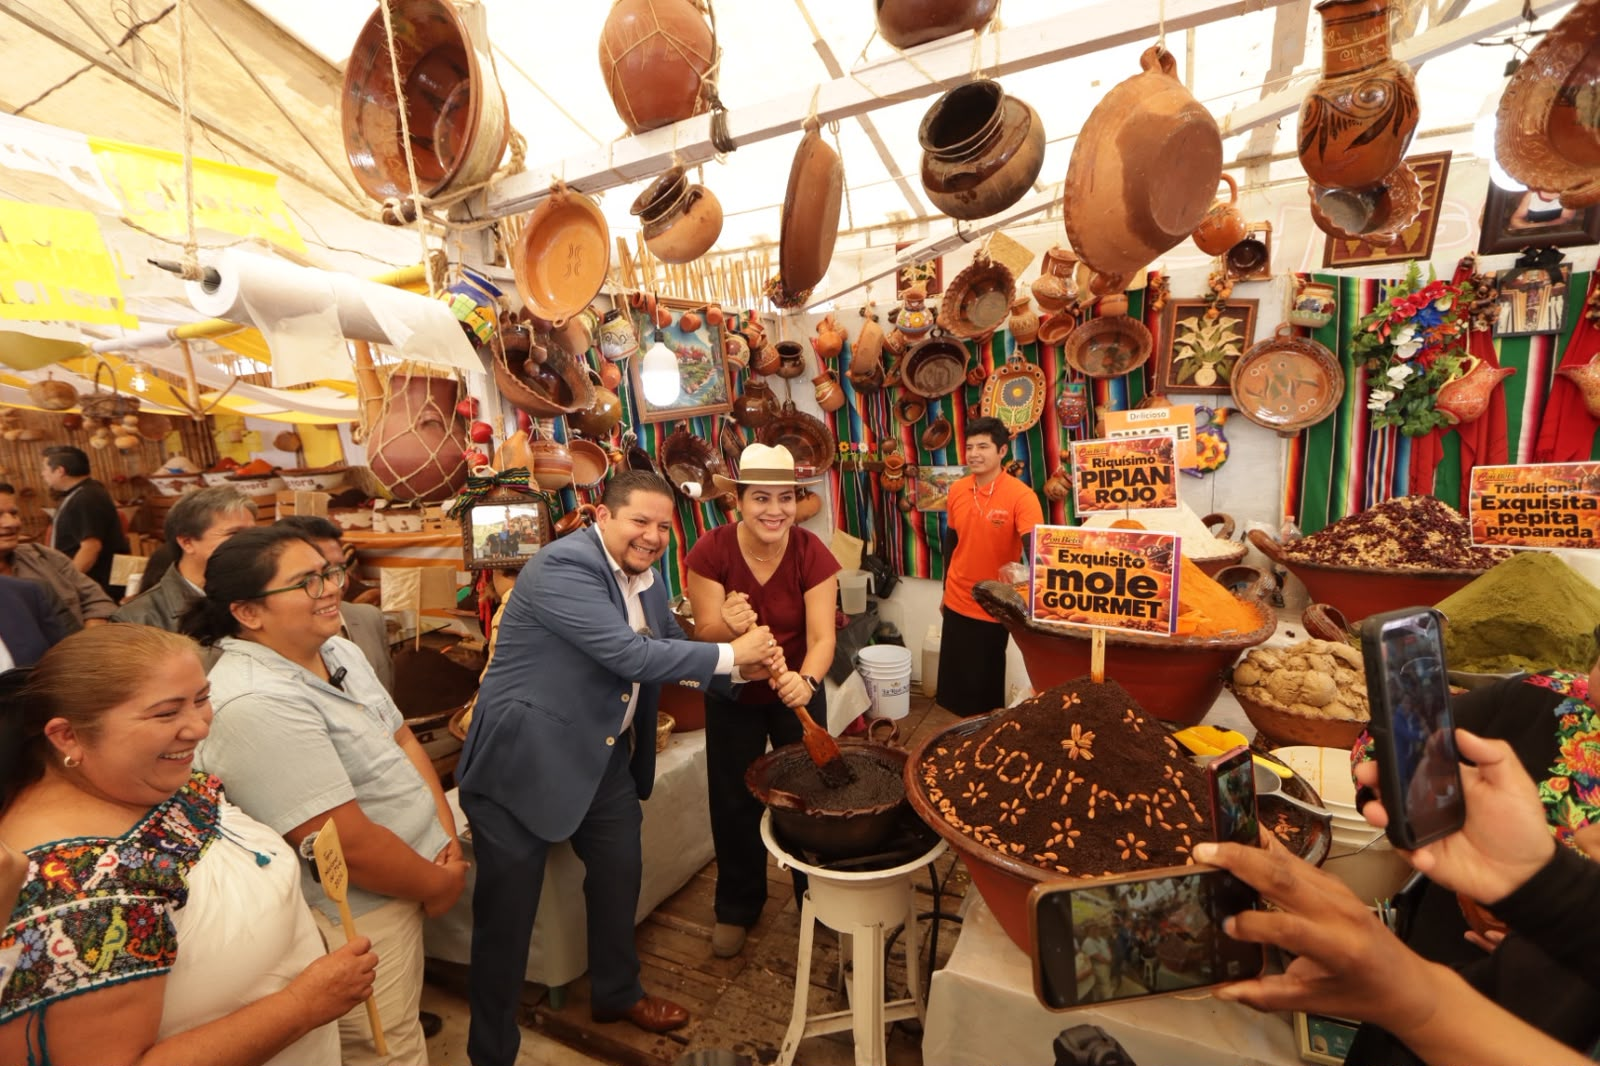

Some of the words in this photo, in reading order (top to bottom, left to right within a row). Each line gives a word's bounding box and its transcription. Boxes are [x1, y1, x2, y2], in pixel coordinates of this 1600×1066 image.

[1092, 456, 1156, 469] Riquísimo
[1081, 465, 1171, 489] PIPIAN
[1095, 486, 1157, 504] ROJO
[1494, 482, 1582, 494] Tradicional
[1480, 494, 1597, 512] Exquisita
[1498, 510, 1578, 527] pepita
[1486, 525, 1593, 539] preparada
[1058, 549, 1145, 569] Exquisito
[1047, 568, 1158, 600] mole
[1043, 591, 1162, 619] GOURMET
